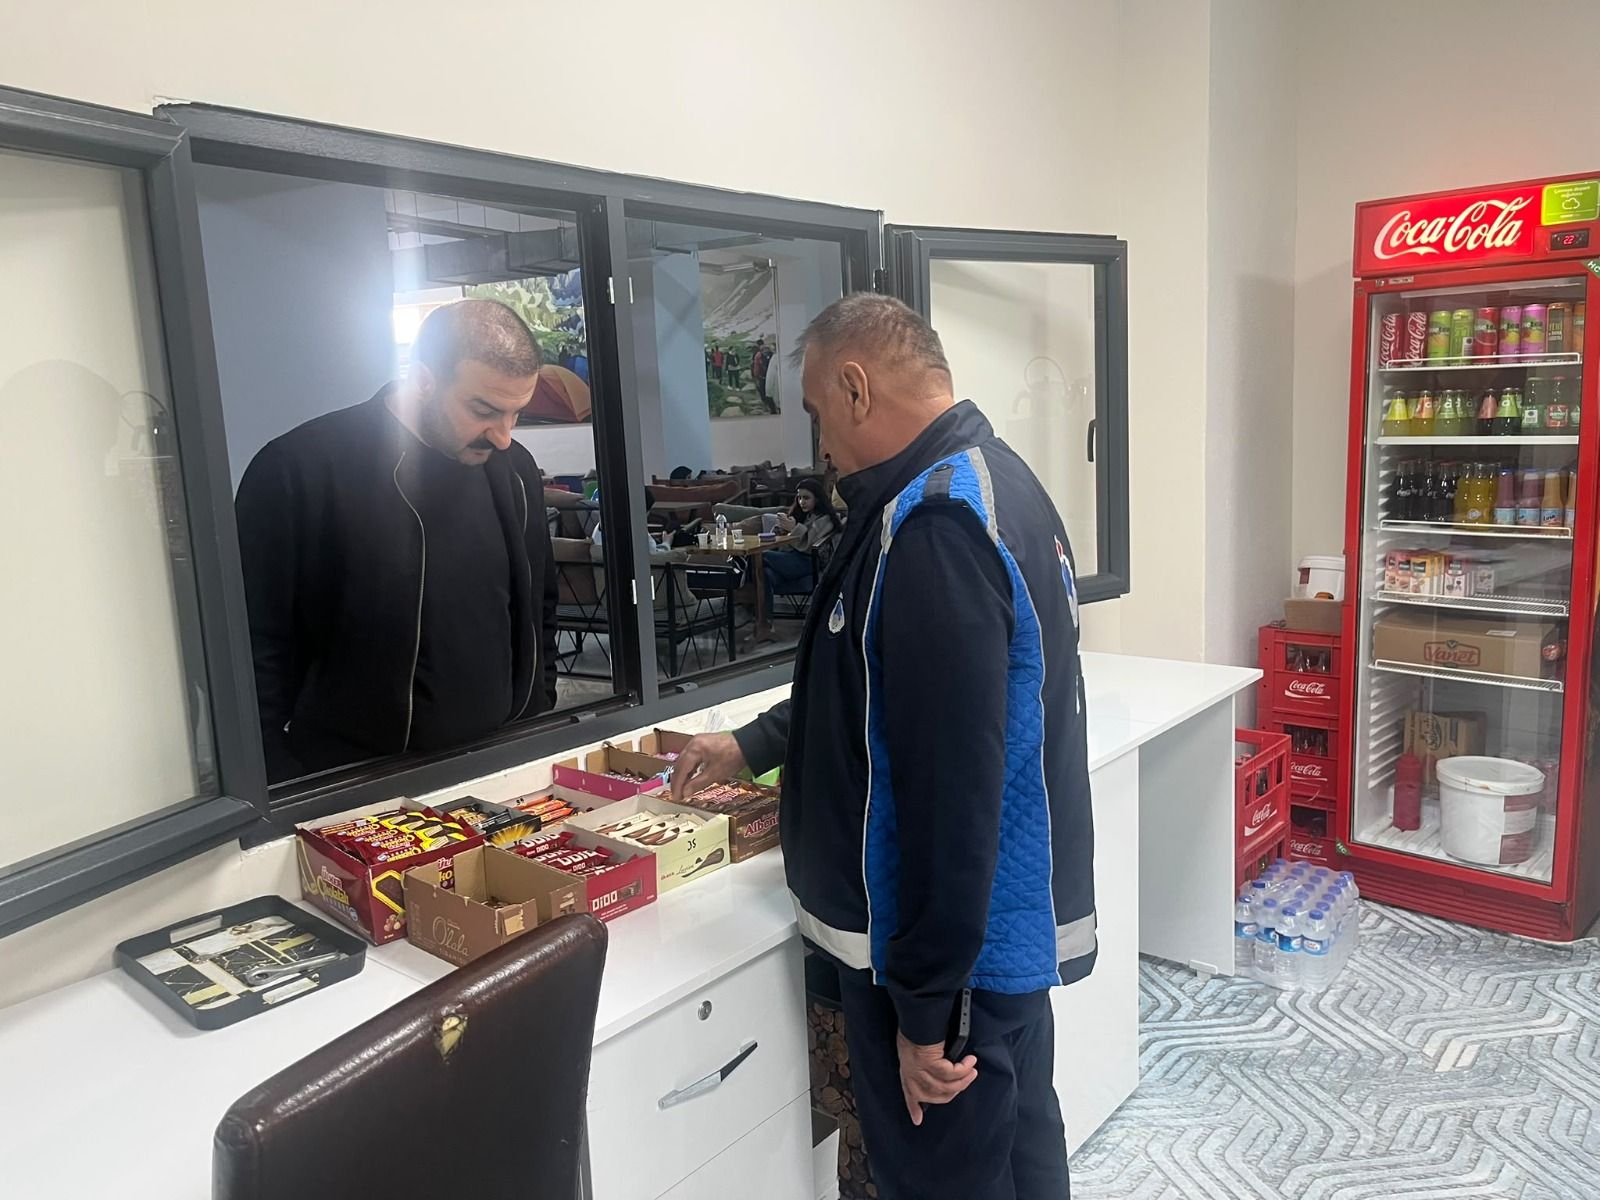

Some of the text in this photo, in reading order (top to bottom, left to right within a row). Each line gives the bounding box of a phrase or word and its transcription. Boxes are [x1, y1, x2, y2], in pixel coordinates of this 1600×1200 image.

[1374, 196, 1534, 259] Coca-Cola
[1427, 646, 1476, 663] Vanet
[1289, 680, 1326, 694] Coca-Cola
[1291, 761, 1323, 776] oca-Cola
[1290, 840, 1323, 855] oca-Cola
